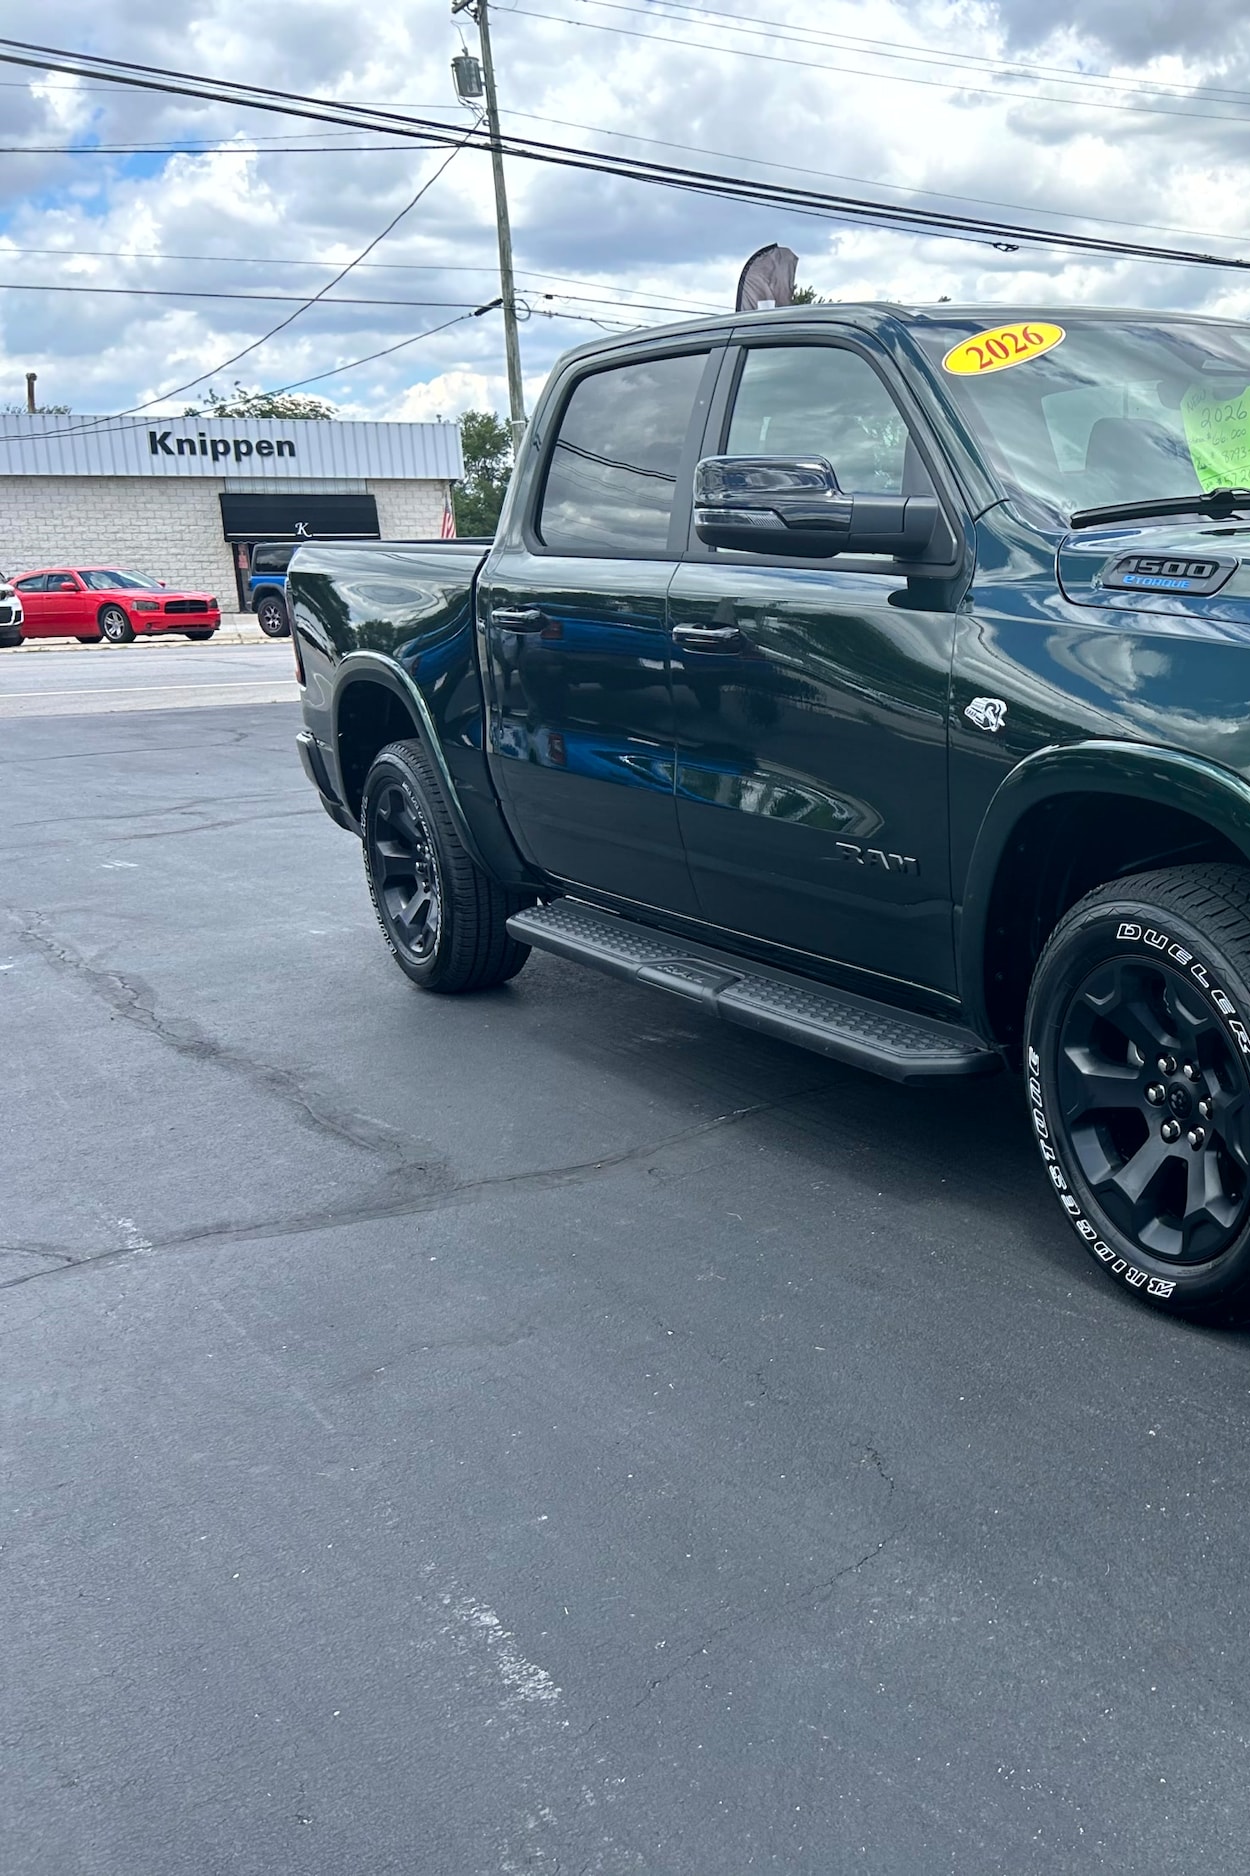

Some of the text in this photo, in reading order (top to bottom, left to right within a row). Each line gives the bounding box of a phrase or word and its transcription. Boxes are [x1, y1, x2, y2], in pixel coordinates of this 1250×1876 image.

[965, 325, 1044, 369] 2026
[1201, 400, 1248, 428] 2026
[149, 431, 296, 463] Knippen
[295, 522, 313, 538] K
[1119, 559, 1213, 578] 1500
[834, 841, 920, 876] RAM
[1028, 1046, 1176, 1299] BRIDGESTONE
